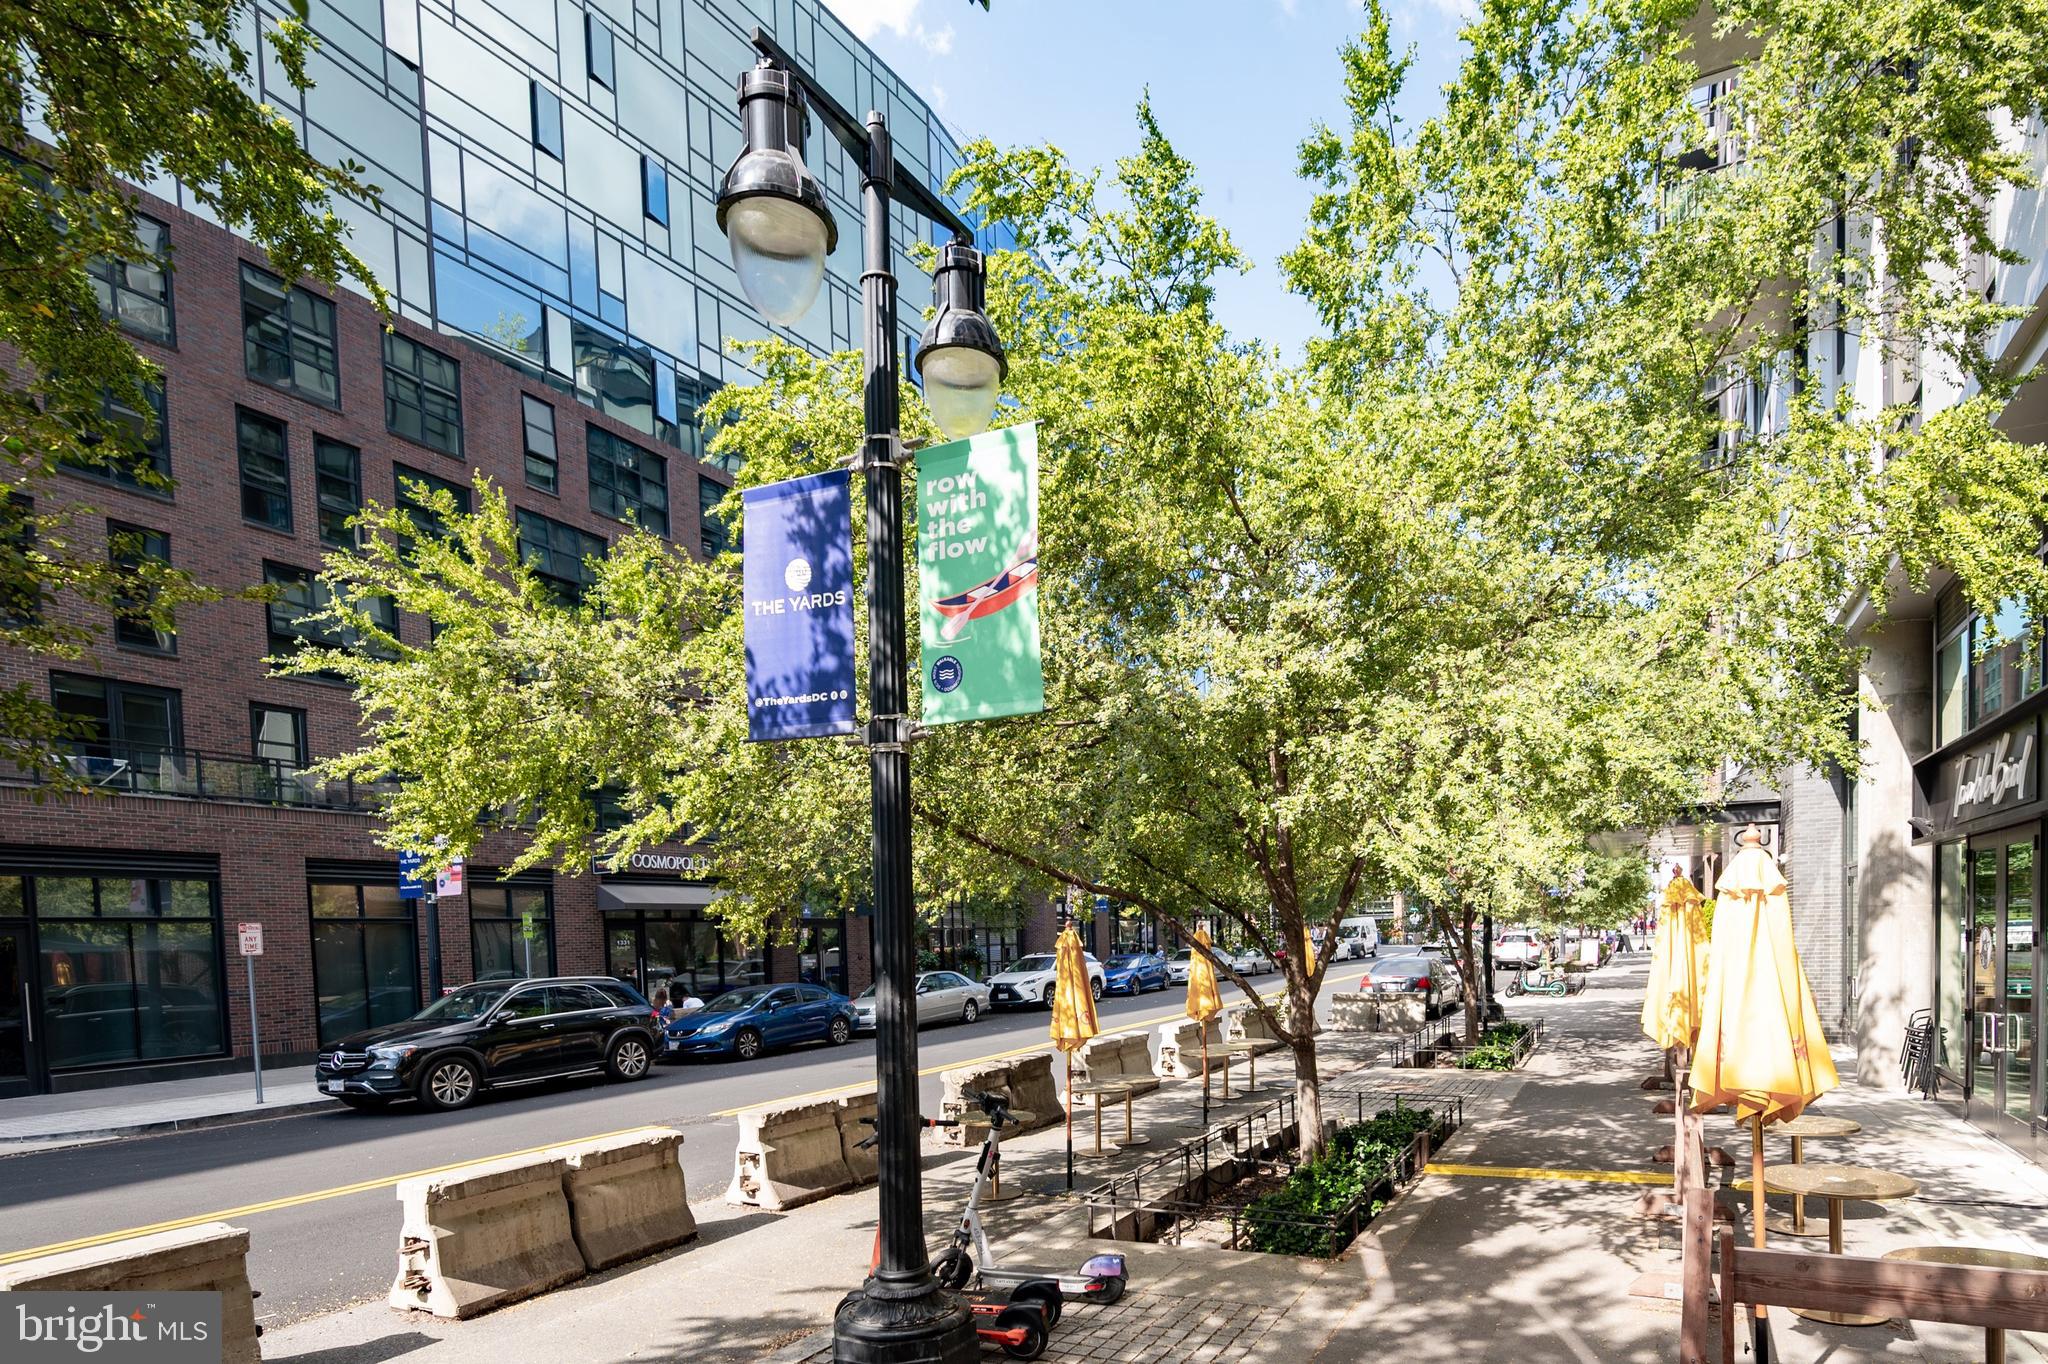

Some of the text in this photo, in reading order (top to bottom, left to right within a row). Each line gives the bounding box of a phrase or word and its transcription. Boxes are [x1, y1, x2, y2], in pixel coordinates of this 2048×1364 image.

[926, 470, 978, 496] row
[926, 488, 987, 518] with
[927, 518, 972, 540] the
[927, 536, 988, 562] flow
[752, 591, 846, 616] THE YARDS
[754, 692, 828, 708] @TheYardsDC
